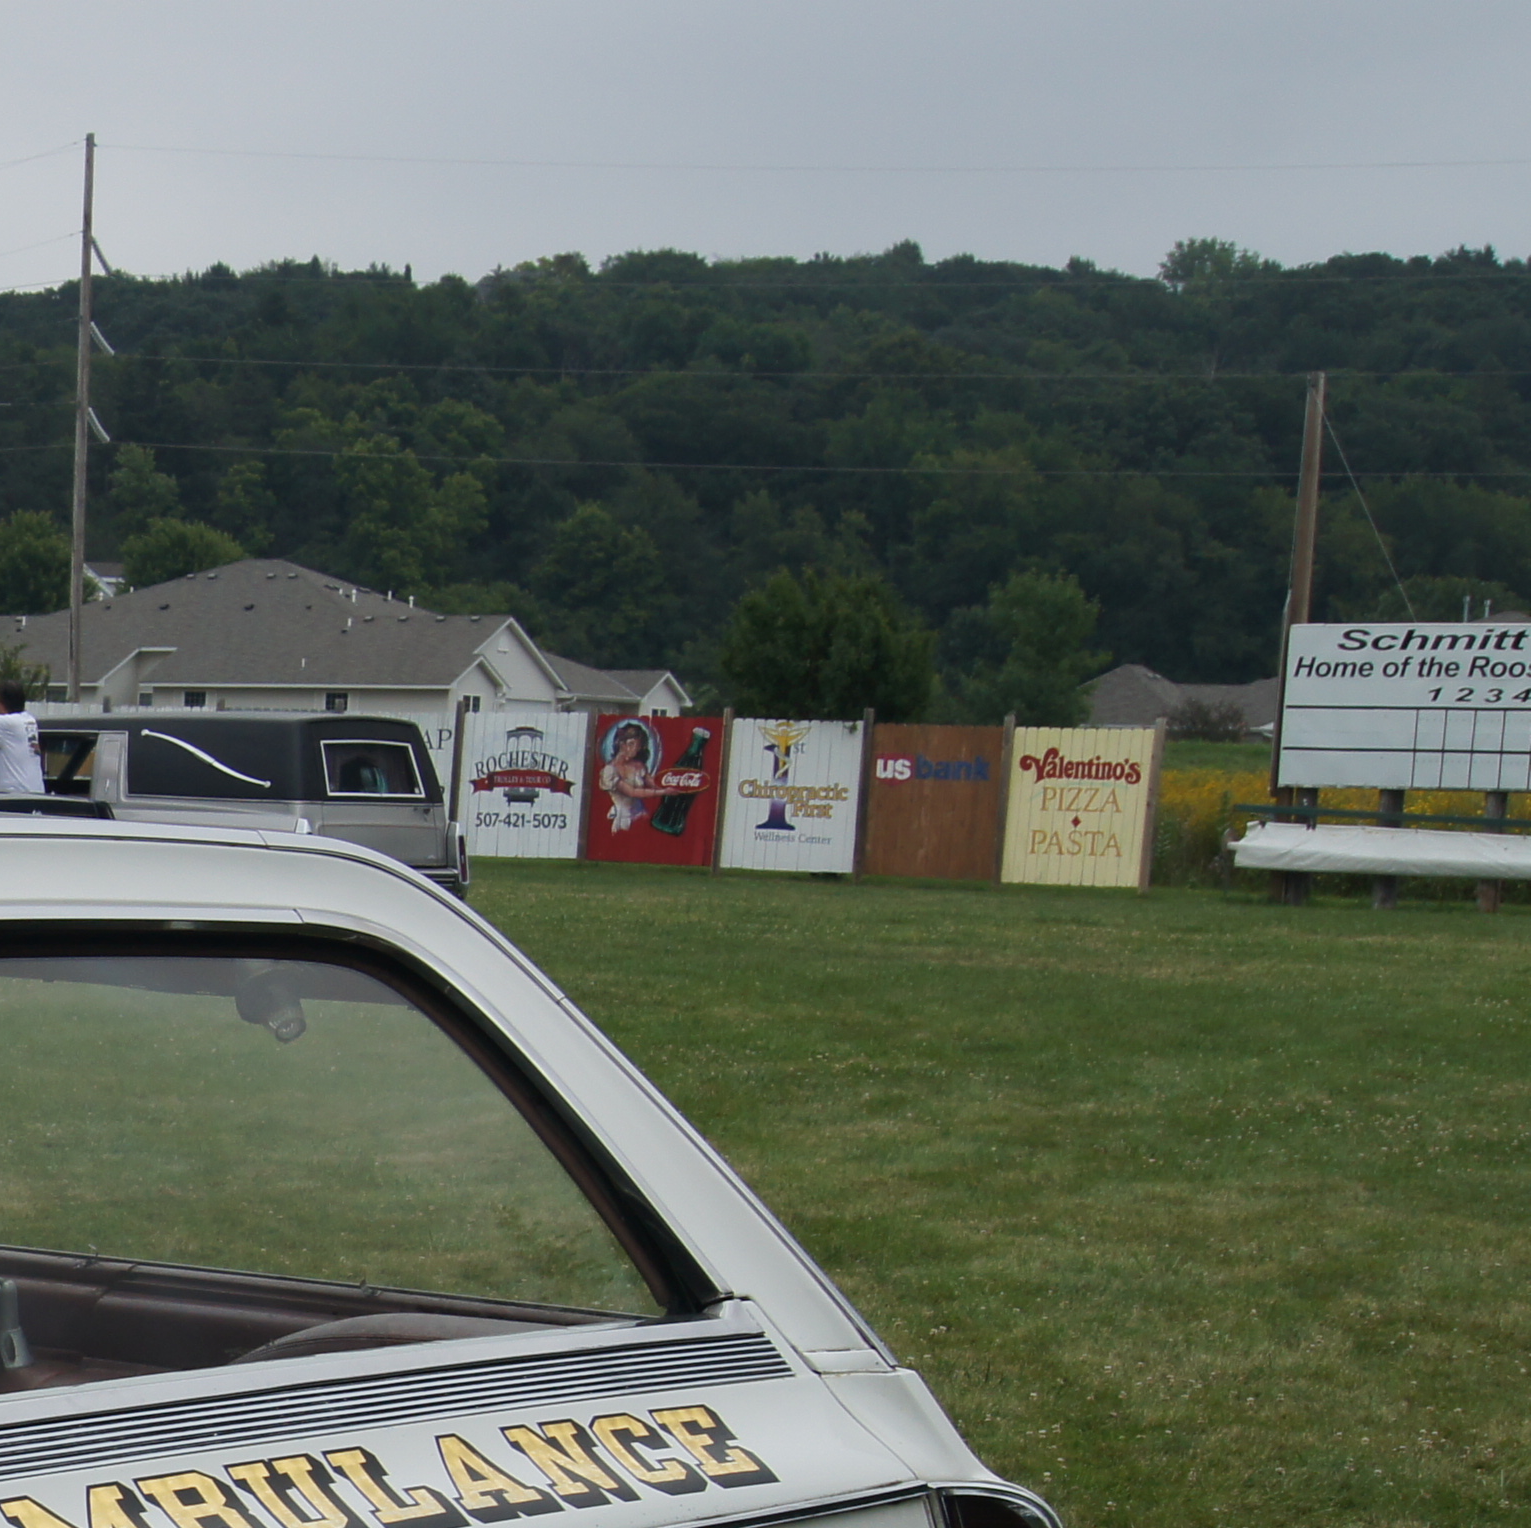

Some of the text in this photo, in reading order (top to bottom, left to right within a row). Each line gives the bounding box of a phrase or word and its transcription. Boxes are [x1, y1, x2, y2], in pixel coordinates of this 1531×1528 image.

[1337, 628, 1529, 651] Schmitt
[1293, 656, 1374, 678] Home
[1382, 656, 1414, 678] of
[1416, 656, 1460, 678] the
[1428, 687, 1531, 703] 1 2 3 4
[475, 750, 569, 782] ROCHESTER
[876, 754, 989, 782] us bank
[1020, 747, 1142, 785] Valentino's
[661, 771, 703, 787] Coca-Cola
[738, 778, 850, 804] Chiropractic
[1039, 787, 1122, 812] PIZZA
[475, 812, 567, 829] 507-421-5073
[790, 802, 833, 819] First
[754, 831, 832, 845] Wellness Center
[1029, 830, 1123, 857] PASTA
